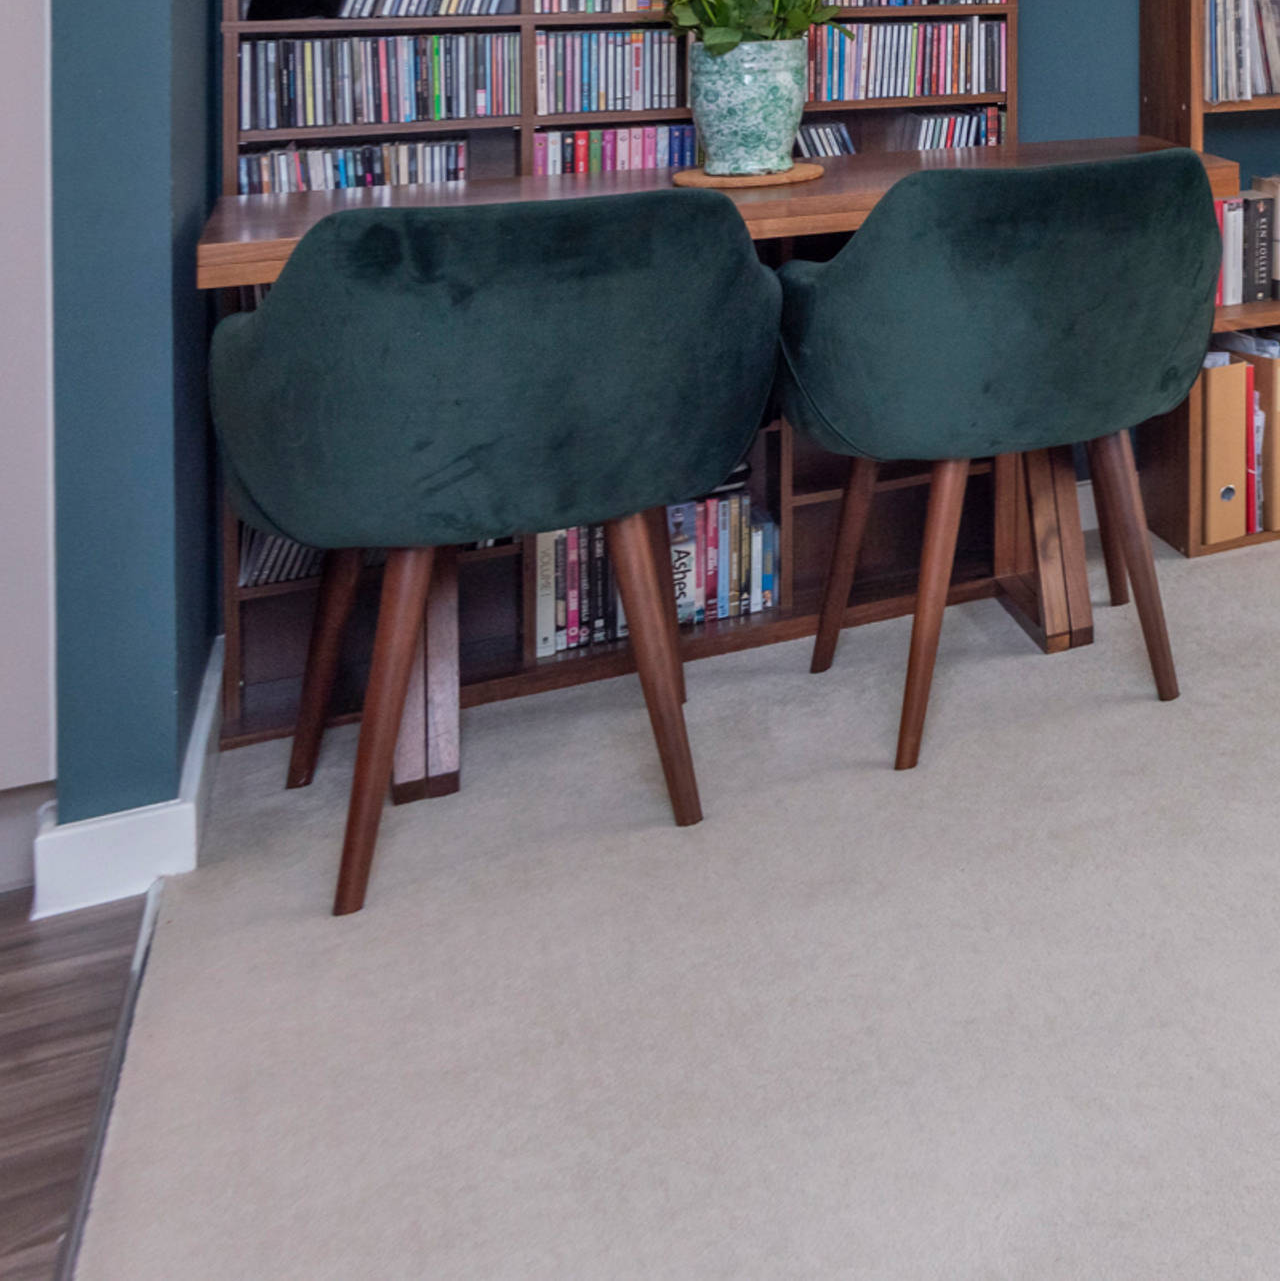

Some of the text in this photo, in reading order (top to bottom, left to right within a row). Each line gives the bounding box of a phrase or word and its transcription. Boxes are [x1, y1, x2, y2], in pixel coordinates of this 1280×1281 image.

[1259, 217, 1268, 285] KEN FOLLETT
[539, 548, 553, 589] VOLUME
[673, 549, 691, 600] Ashes
